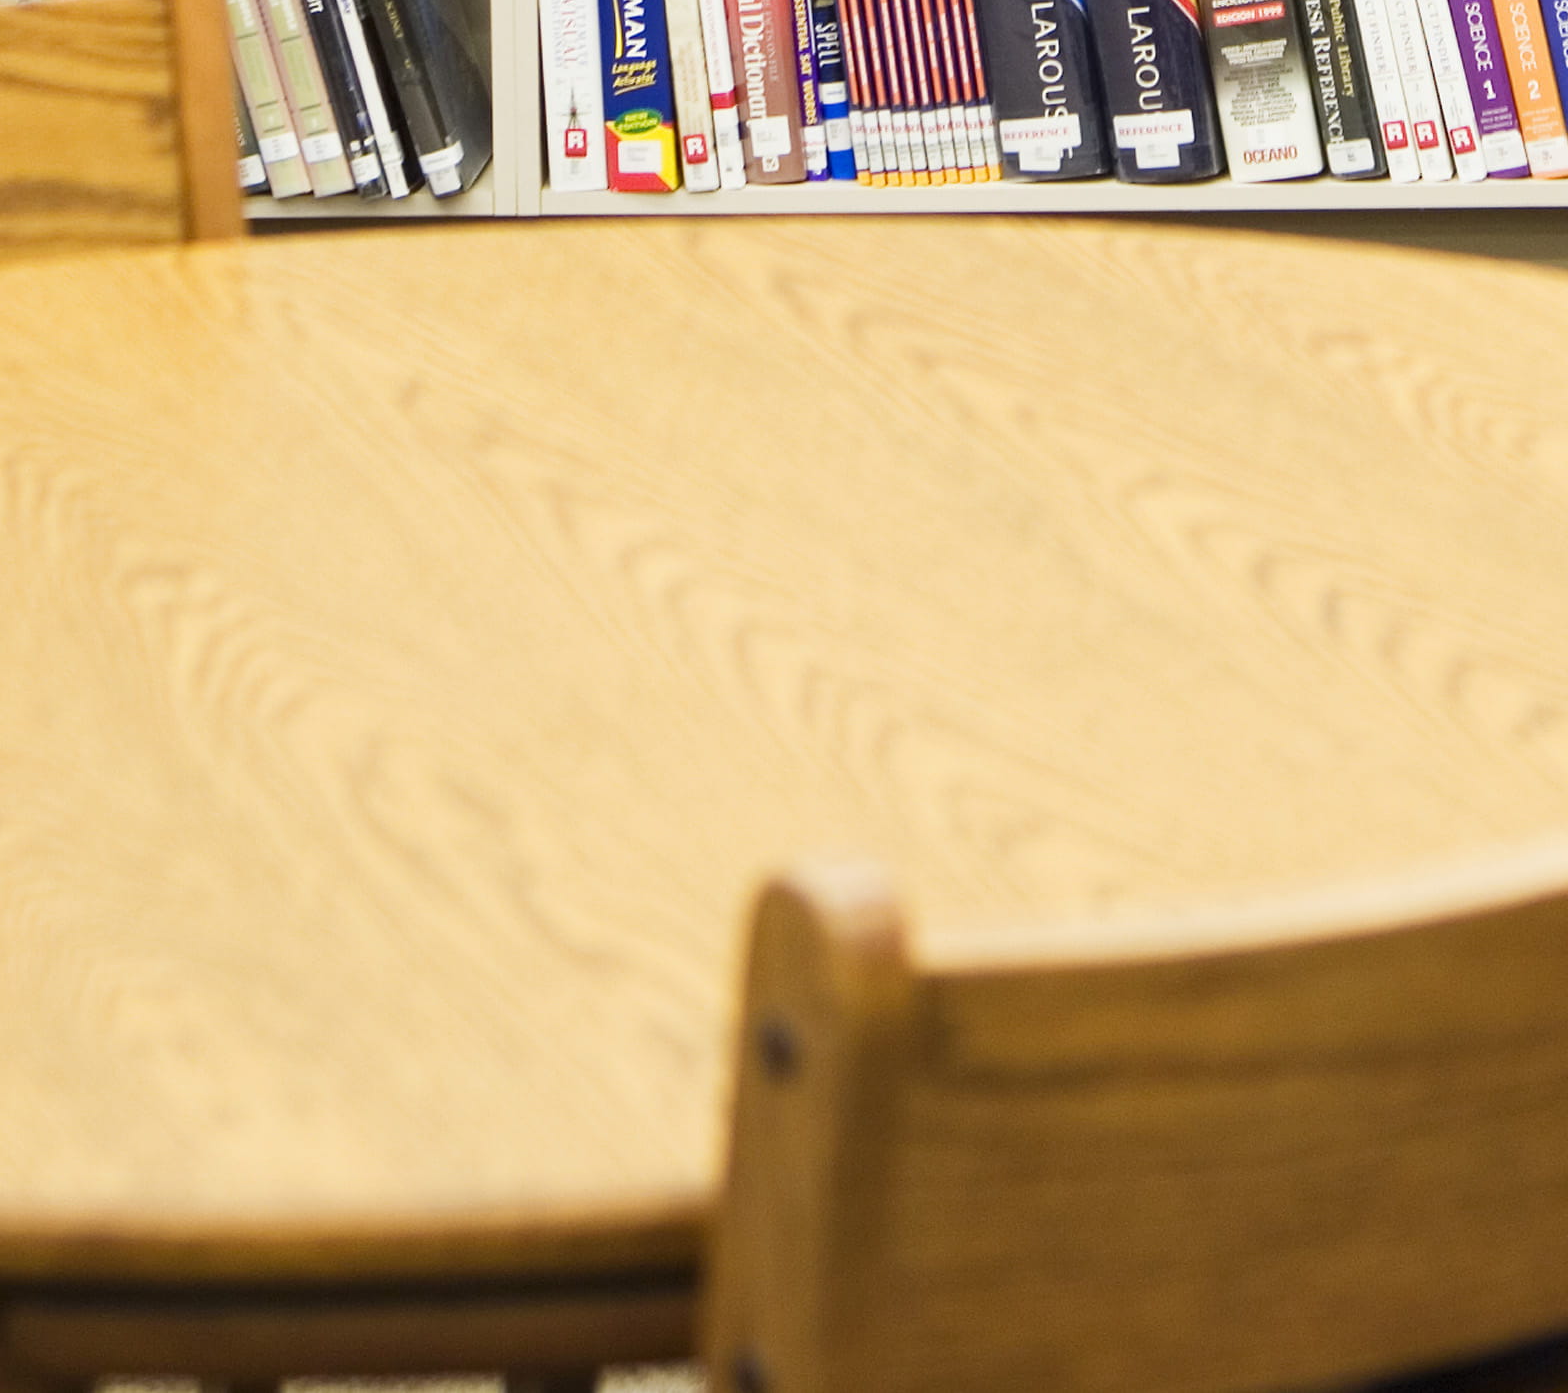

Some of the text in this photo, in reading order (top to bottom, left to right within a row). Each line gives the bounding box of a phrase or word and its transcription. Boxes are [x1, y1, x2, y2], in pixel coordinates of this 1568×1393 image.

[1127, 6, 1163, 113] LAROU
[1465, 2, 1493, 71] SCIENCE
[1483, 81, 1496, 100] 1
